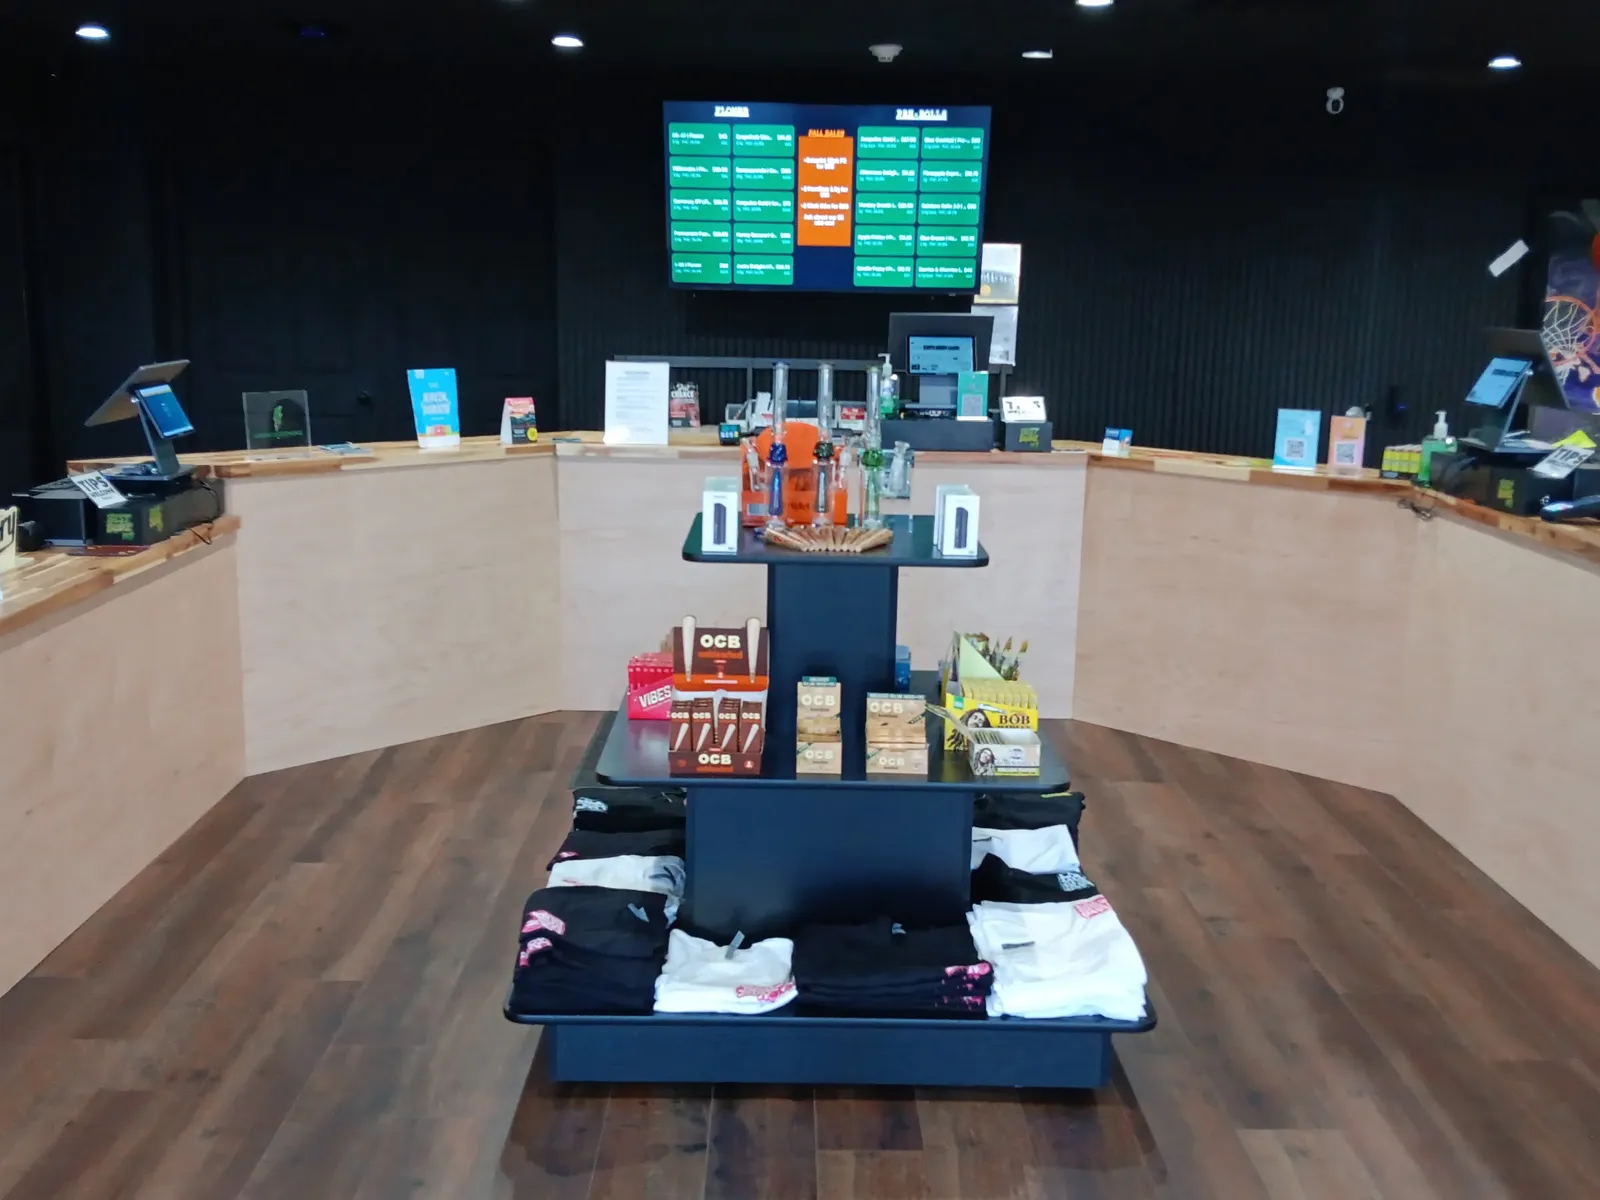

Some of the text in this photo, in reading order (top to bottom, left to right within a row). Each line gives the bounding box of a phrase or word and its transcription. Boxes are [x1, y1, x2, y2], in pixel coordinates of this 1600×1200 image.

[1554, 448, 1589, 464] TIPS
[77, 476, 109, 492] TIPS
[700, 634, 741, 649] OCB
[638, 685, 672, 708] VIBES
[801, 694, 836, 706] OCB
[869, 702, 904, 714] OCB
[999, 714, 1031, 725] BOB
[698, 753, 732, 765] OCB
[805, 750, 834, 759] OCB
[878, 757, 905, 766] OCB
